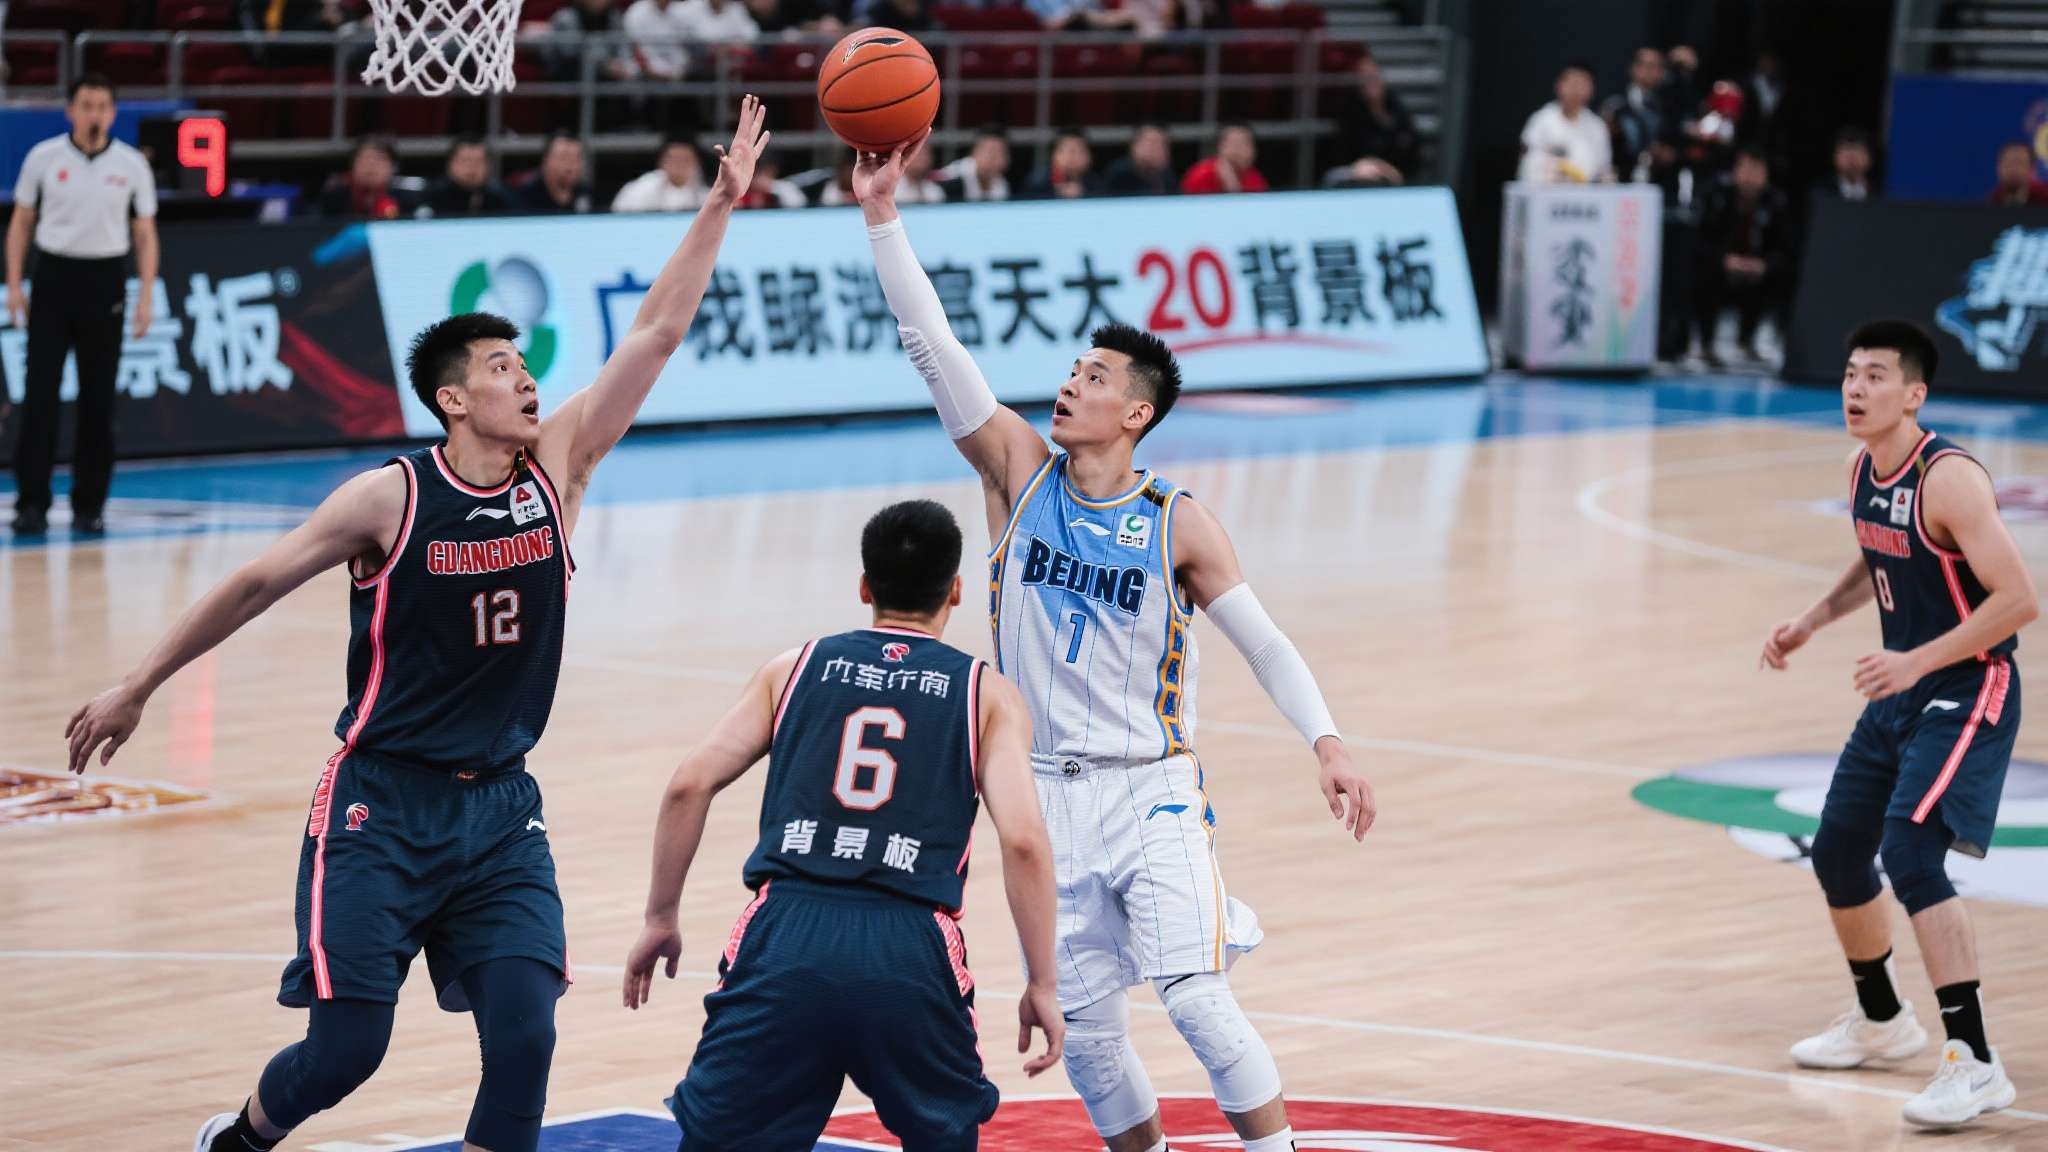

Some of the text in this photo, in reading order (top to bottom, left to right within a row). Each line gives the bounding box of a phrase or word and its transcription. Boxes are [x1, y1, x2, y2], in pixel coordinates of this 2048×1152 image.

[178, 118, 226, 197] 9
[427, 525, 553, 575] GUANGDONG
[1021, 534, 1148, 617] BEIJING
[470, 588, 522, 647] 12
[832, 705, 906, 811] 6
